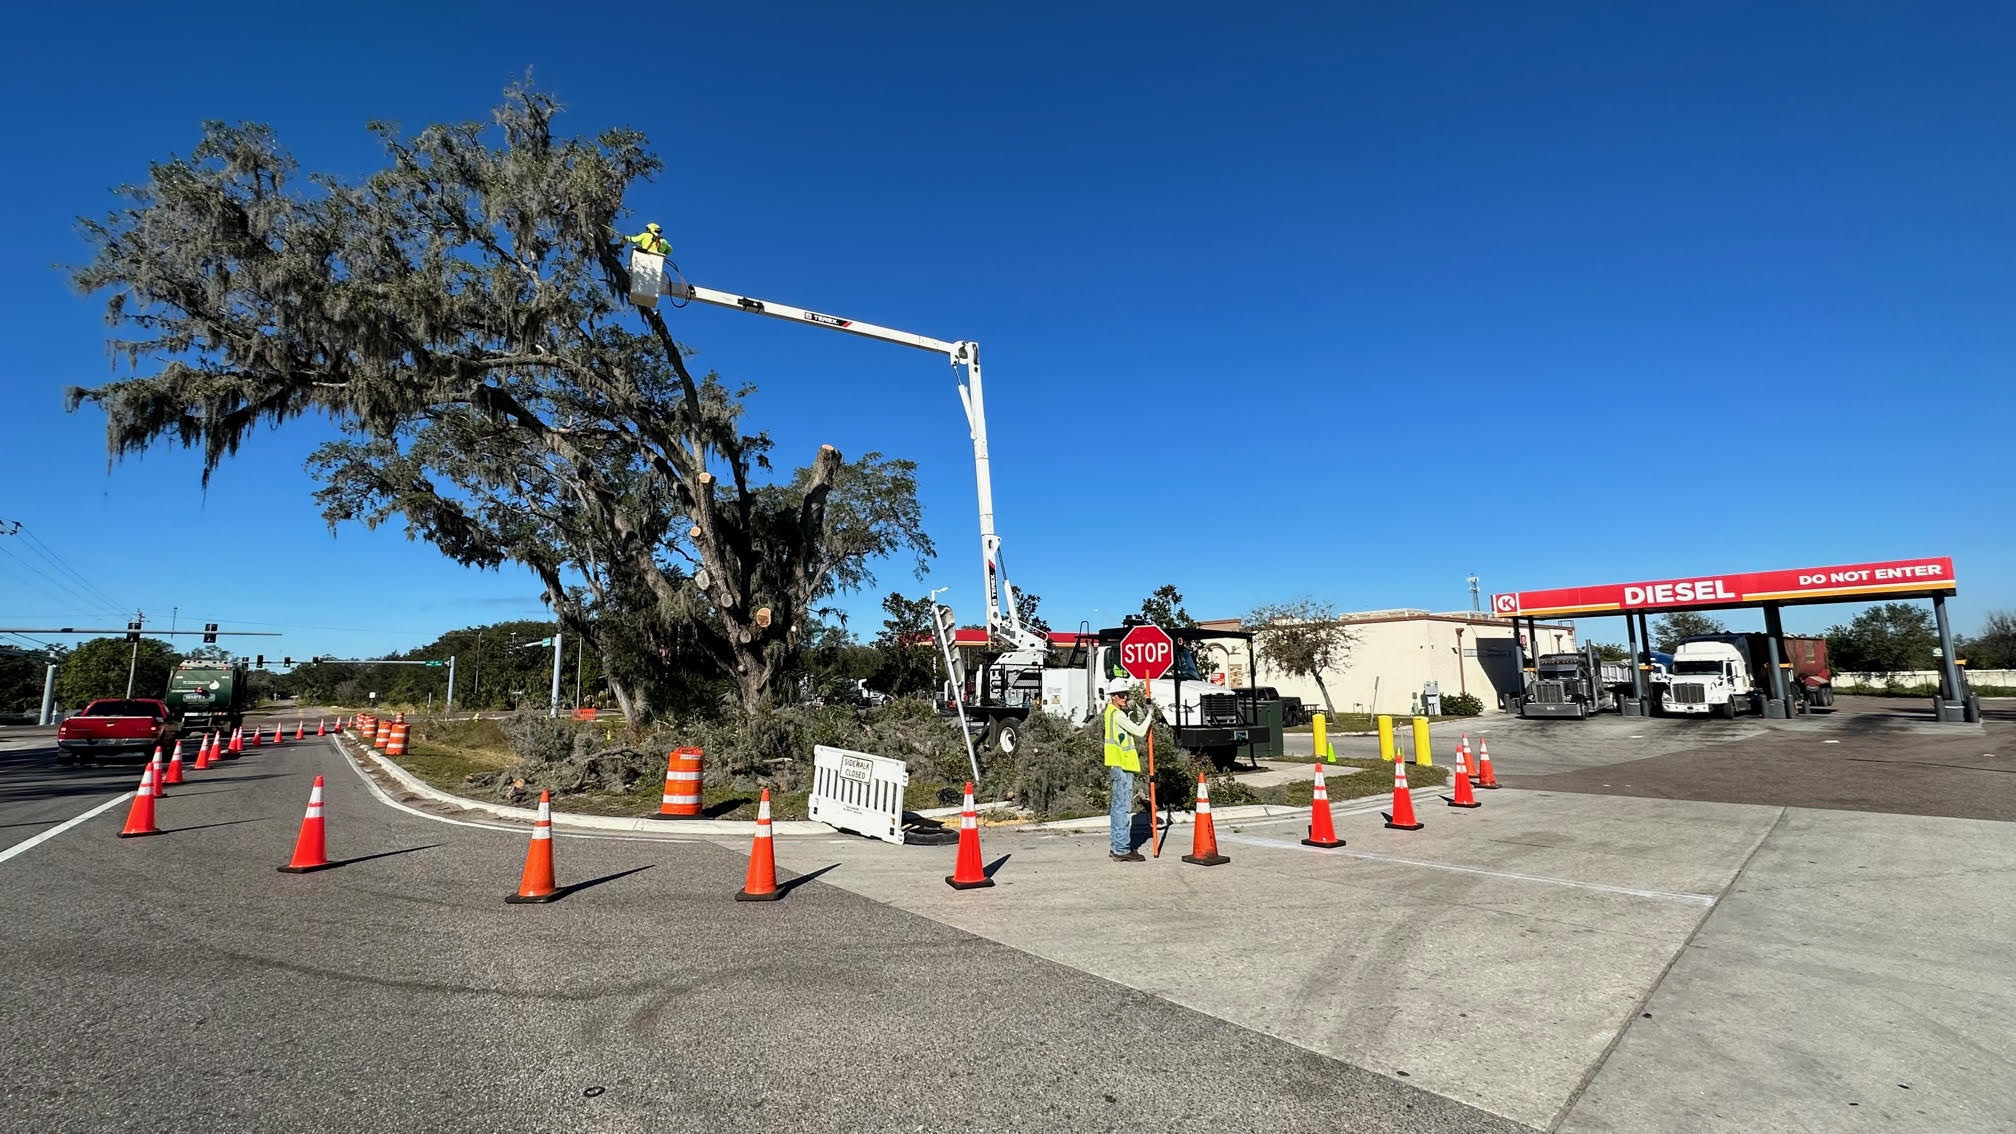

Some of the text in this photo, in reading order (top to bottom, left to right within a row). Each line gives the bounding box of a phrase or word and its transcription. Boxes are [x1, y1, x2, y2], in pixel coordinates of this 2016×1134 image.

[814, 315, 838, 324] TEREX
[1798, 564, 1942, 586] DO NOT ENTER
[1623, 580, 1735, 605] DIESEL
[1501, 597, 1514, 609] K
[1124, 642, 1169, 664] STOP
[844, 758, 870, 770] SIDEWALK
[845, 768, 866, 780] CLOSED
